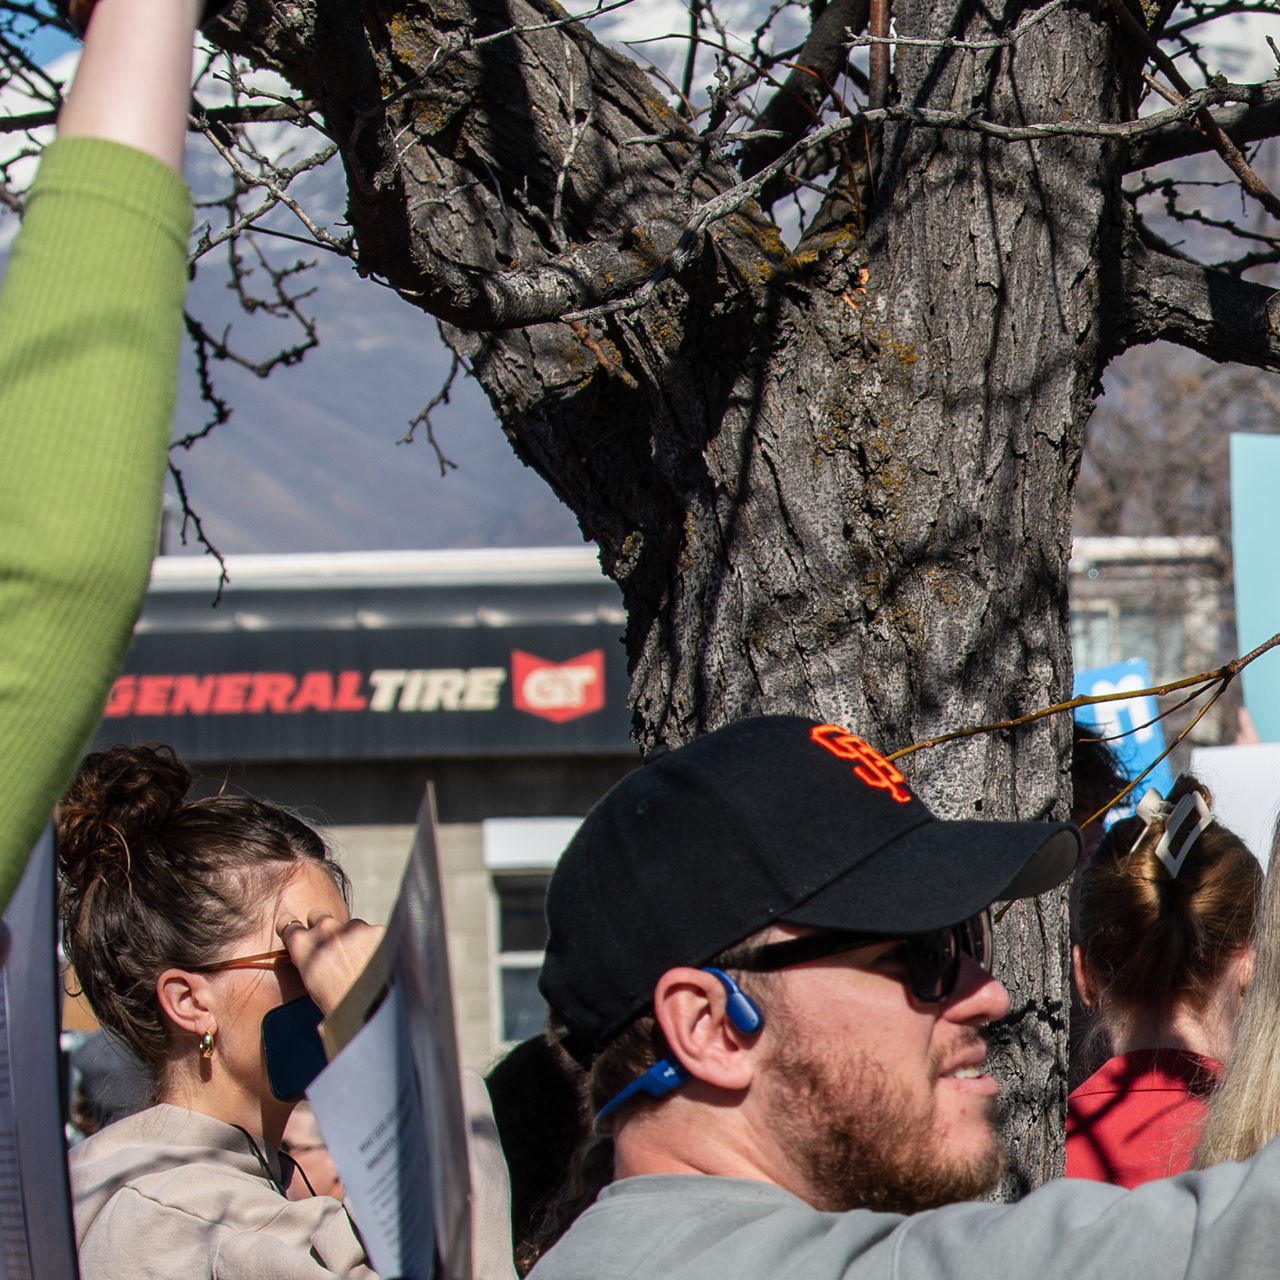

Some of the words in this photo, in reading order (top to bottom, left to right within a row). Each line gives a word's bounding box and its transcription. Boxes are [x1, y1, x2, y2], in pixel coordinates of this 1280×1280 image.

[104, 670, 367, 719] GENERAL
[368, 666, 507, 713] TIRE
[521, 664, 599, 711] GT
